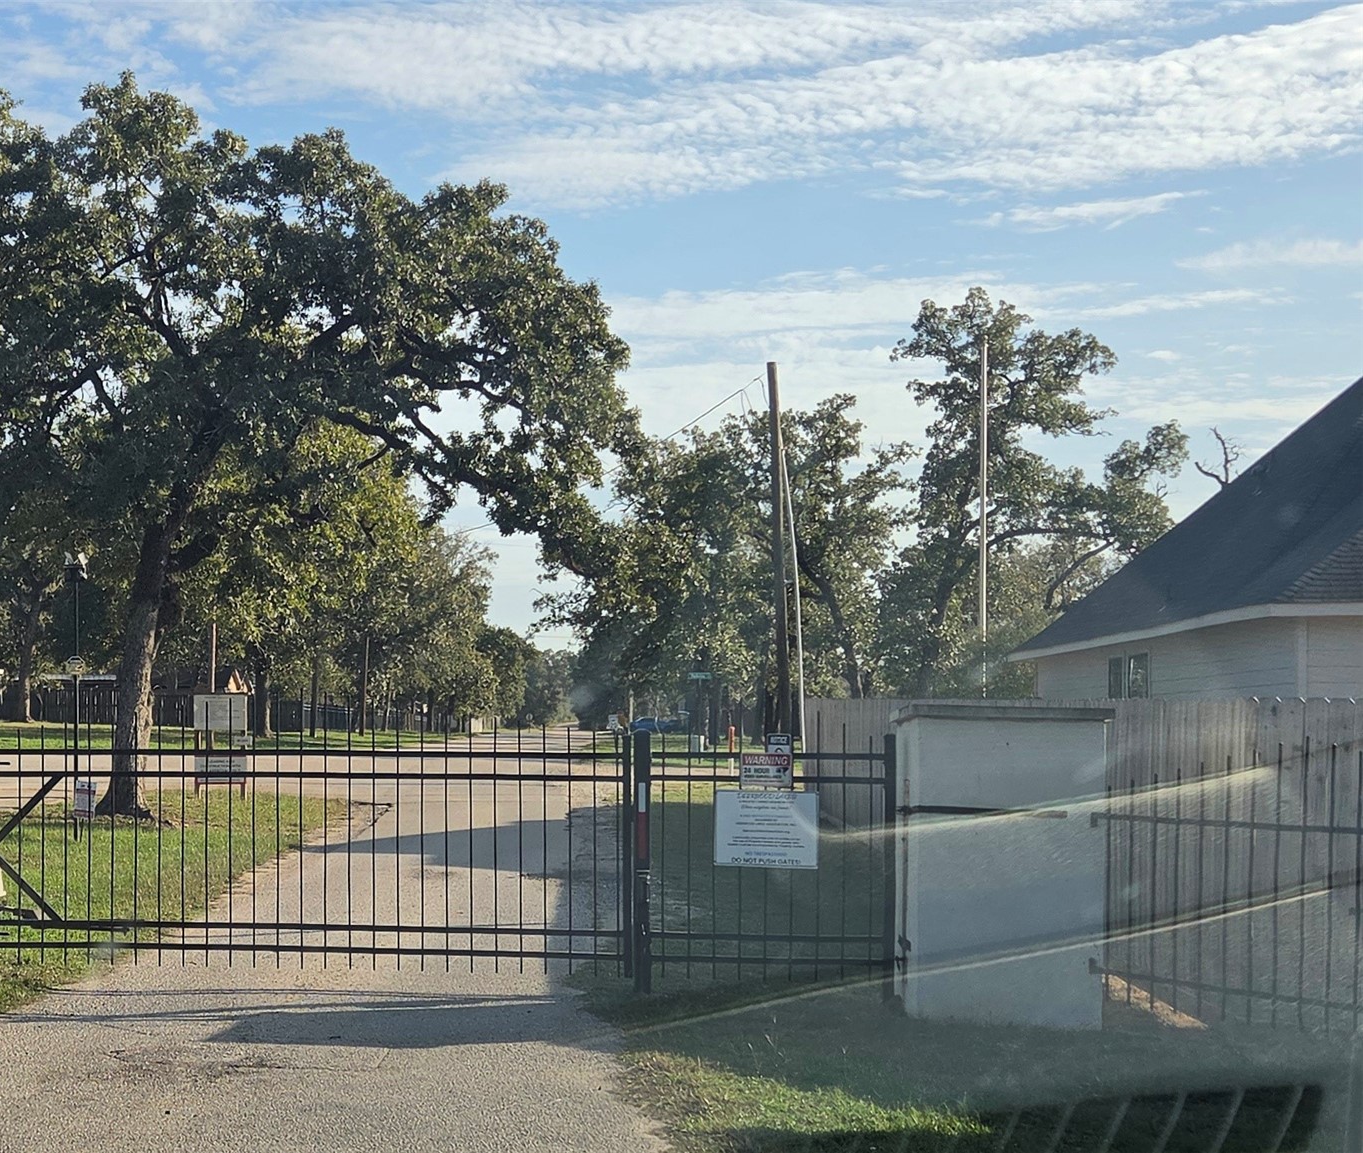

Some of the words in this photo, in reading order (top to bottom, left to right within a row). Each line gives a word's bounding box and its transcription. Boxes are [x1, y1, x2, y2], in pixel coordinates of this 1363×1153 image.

[744, 756, 788, 765] WARNING
[743, 857, 757, 865] NOT
[759, 857, 777, 865] PUSH
